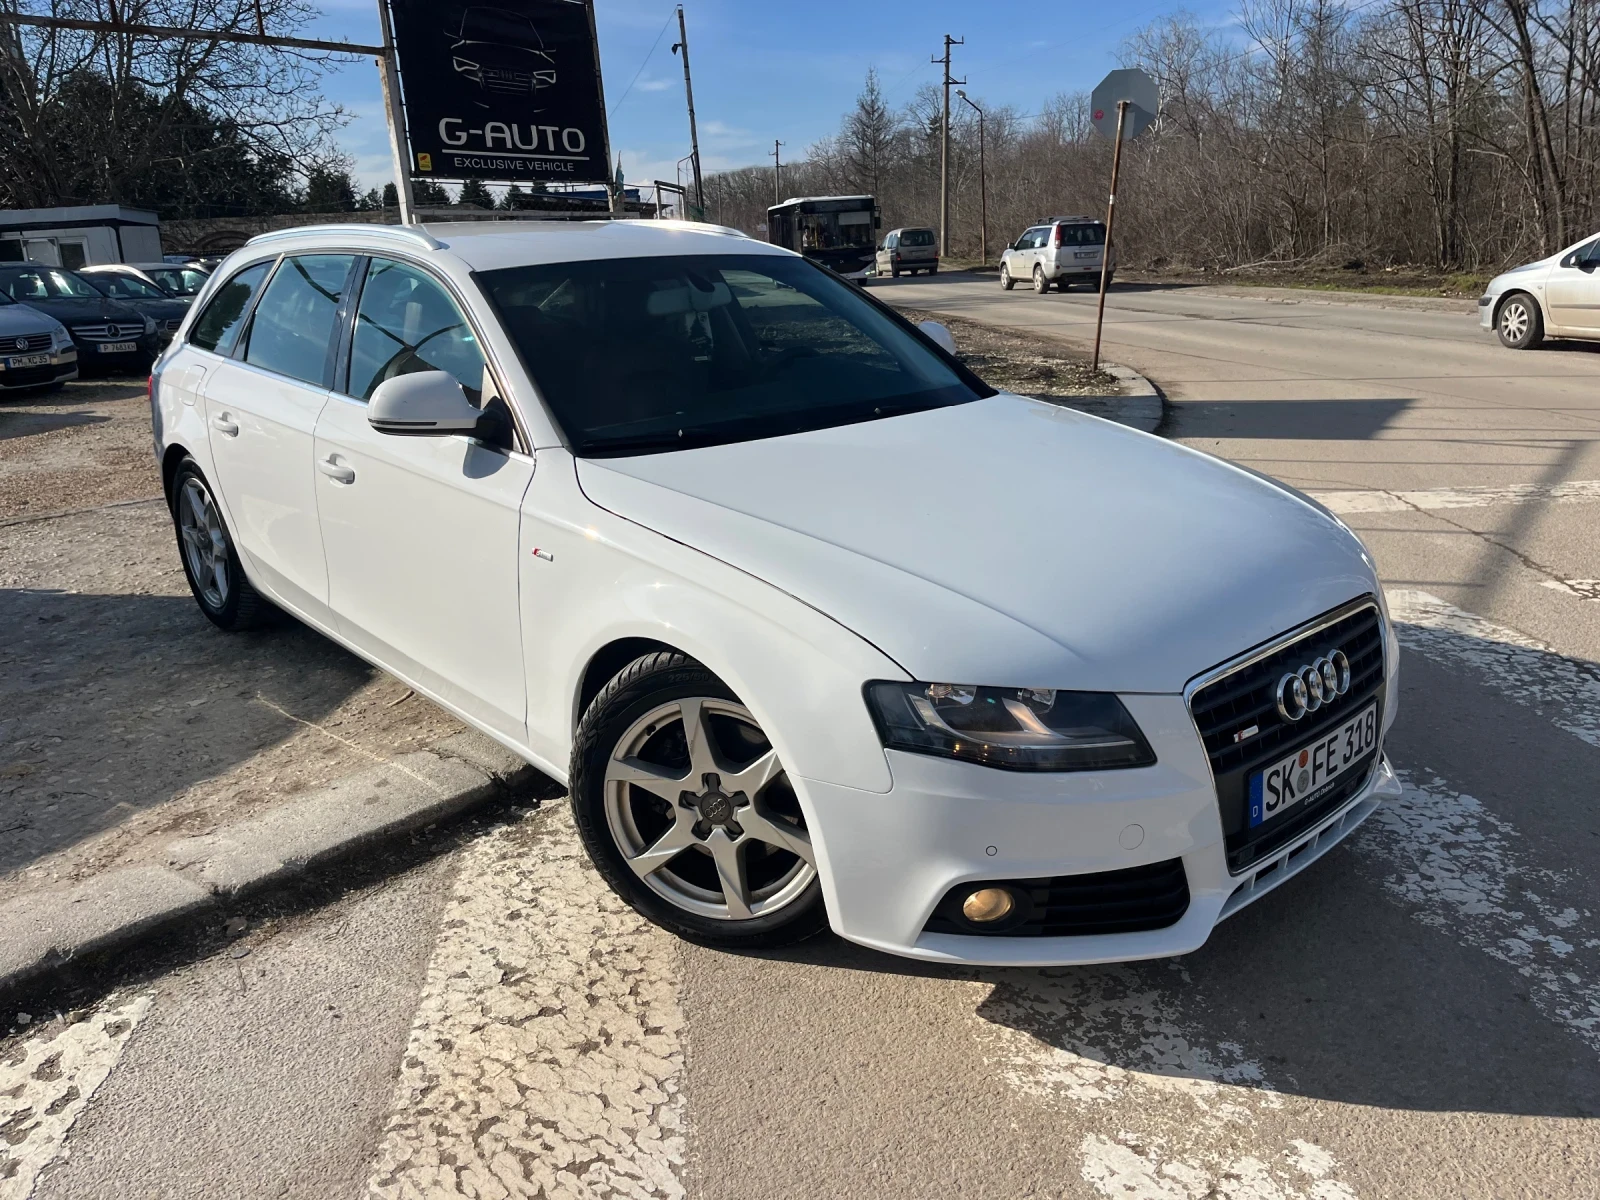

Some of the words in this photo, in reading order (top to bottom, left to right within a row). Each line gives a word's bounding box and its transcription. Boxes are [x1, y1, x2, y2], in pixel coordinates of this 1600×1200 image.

[438, 117, 586, 153] G-AUTO
[454, 157, 525, 170] EXCLUSIVE
[526, 161, 575, 172] VEHICLE
[1265, 759, 1297, 812] SK
[1311, 734, 1339, 787] FE
[1342, 709, 1374, 765] 318
[1252, 805, 1259, 818] D
